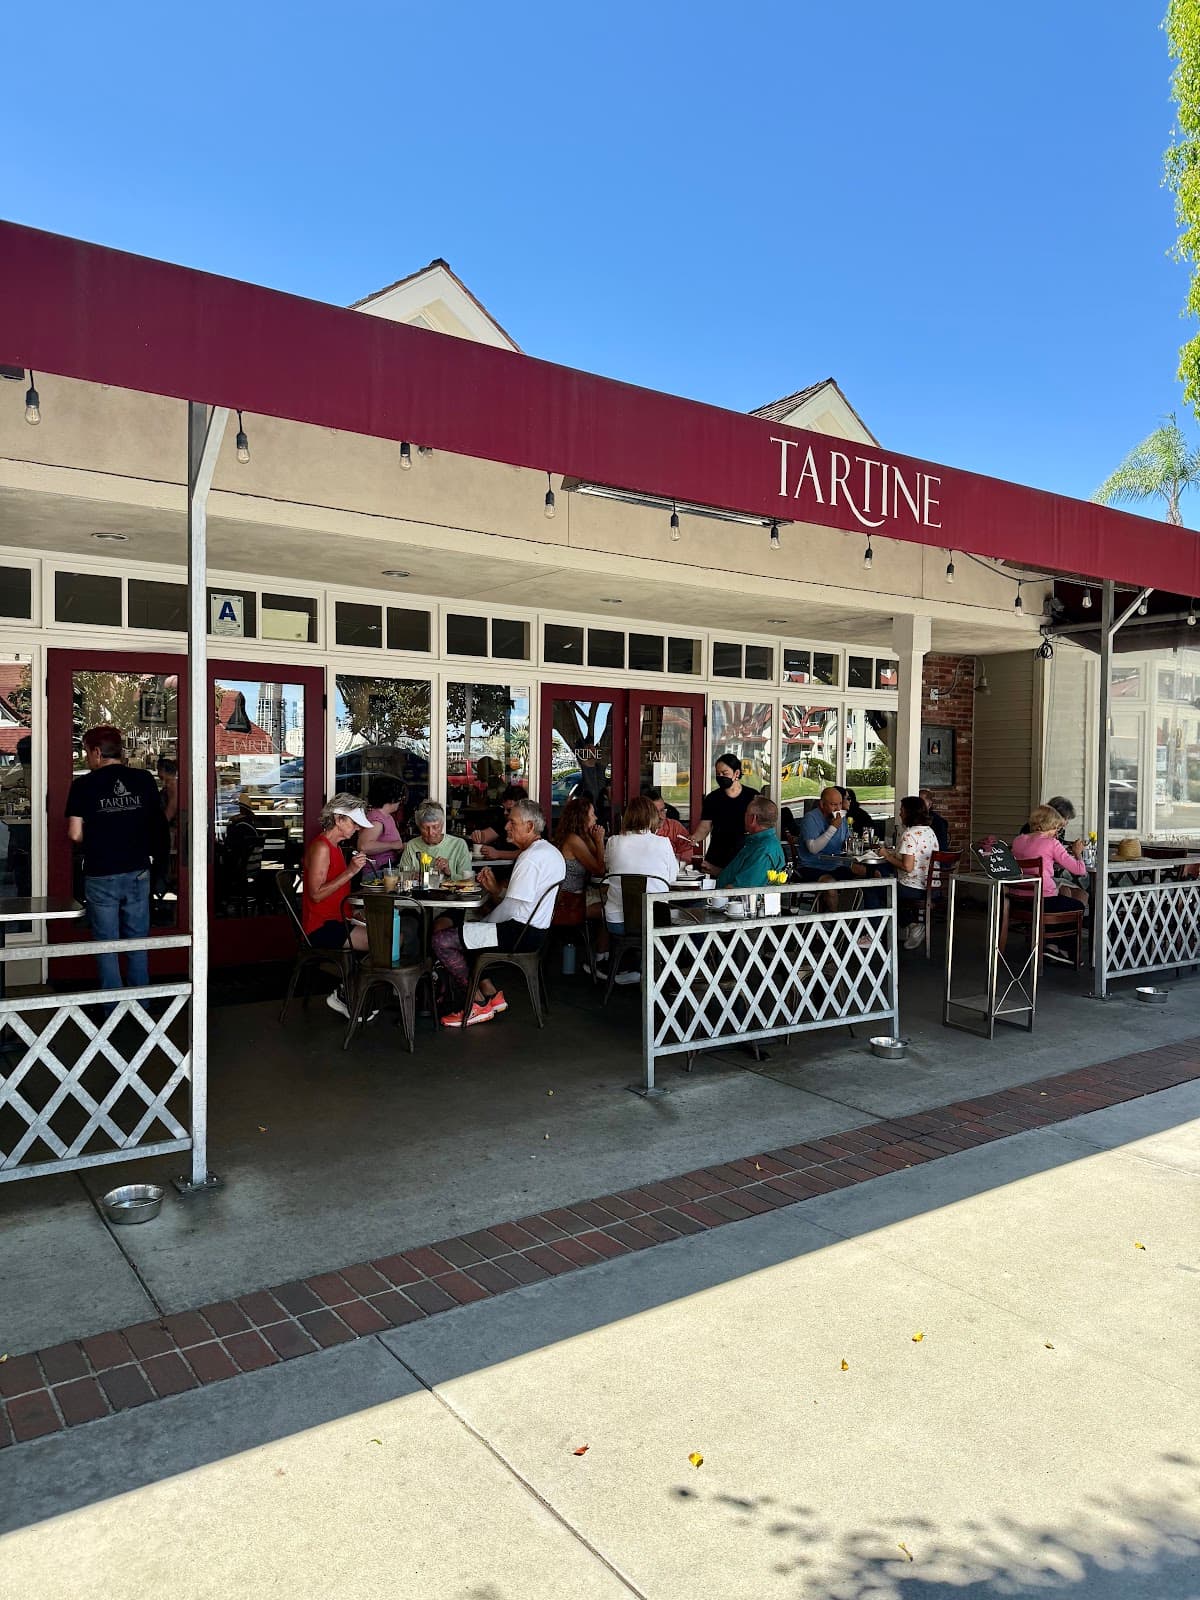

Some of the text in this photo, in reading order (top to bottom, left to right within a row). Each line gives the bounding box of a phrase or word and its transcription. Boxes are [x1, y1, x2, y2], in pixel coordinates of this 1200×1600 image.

[769, 437, 942, 528] TARTINE
[218, 601, 237, 621] A
[560, 748, 602, 761] ARTINE
